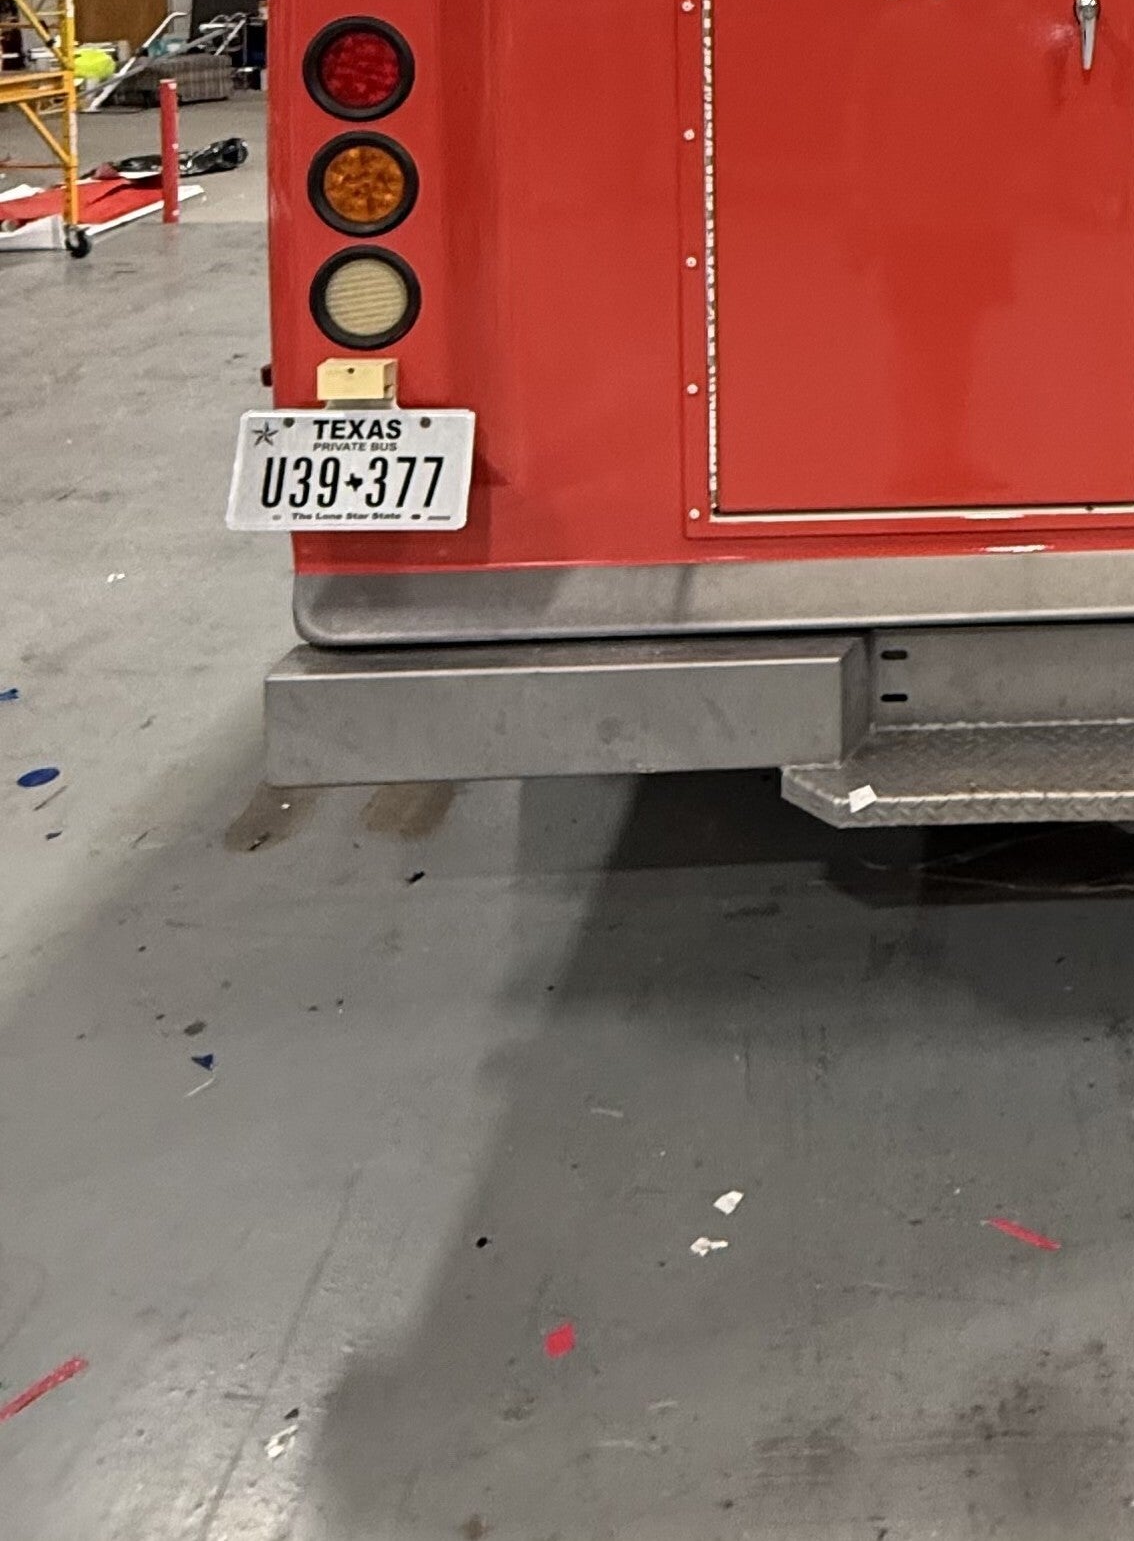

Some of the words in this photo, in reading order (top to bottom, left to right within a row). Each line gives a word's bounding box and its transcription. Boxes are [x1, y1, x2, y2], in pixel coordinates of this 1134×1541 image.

[313, 419, 402, 440] TEXAS
[312, 442, 366, 451] PRIVATE
[370, 442, 398, 451] BUS
